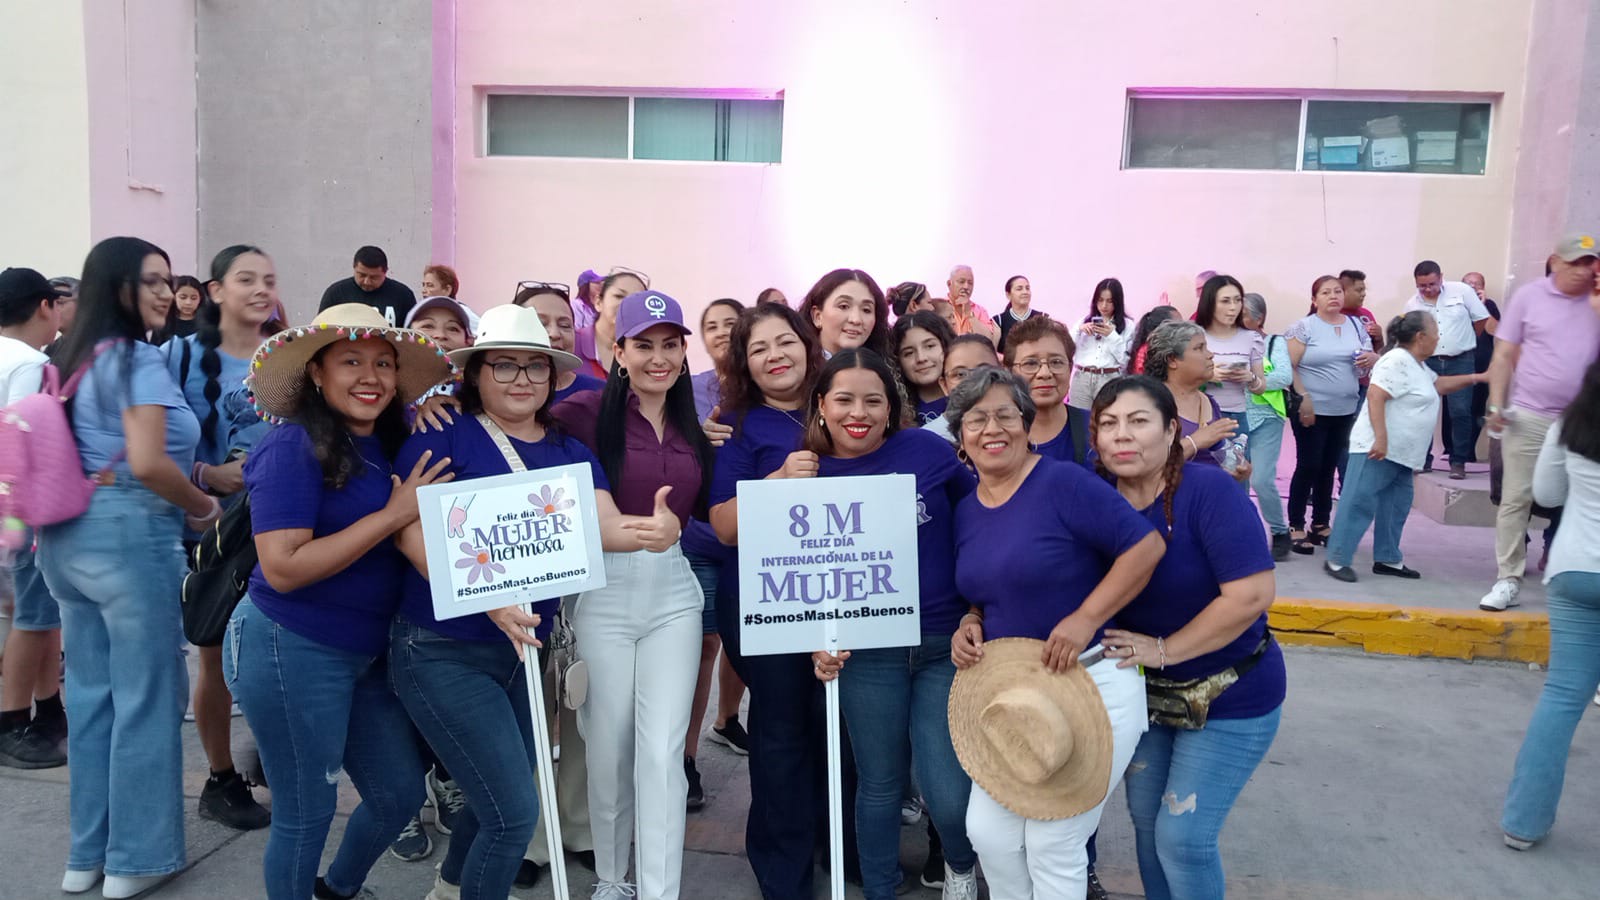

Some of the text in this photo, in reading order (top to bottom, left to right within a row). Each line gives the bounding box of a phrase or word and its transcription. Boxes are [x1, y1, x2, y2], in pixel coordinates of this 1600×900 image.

[496, 512, 518, 522] Feliz
[789, 501, 865, 537] 8 M
[471, 513, 573, 549] MUJER
[801, 535, 855, 549] FELIZ DÍA
[490, 538, 565, 563] hermosa
[861, 551, 876, 561] DE
[879, 550, 894, 560] LA
[457, 567, 587, 597] #SomosMasLosBuenos
[758, 563, 899, 605] MUJER
[744, 605, 915, 625] #SomosMasLosBuenos
